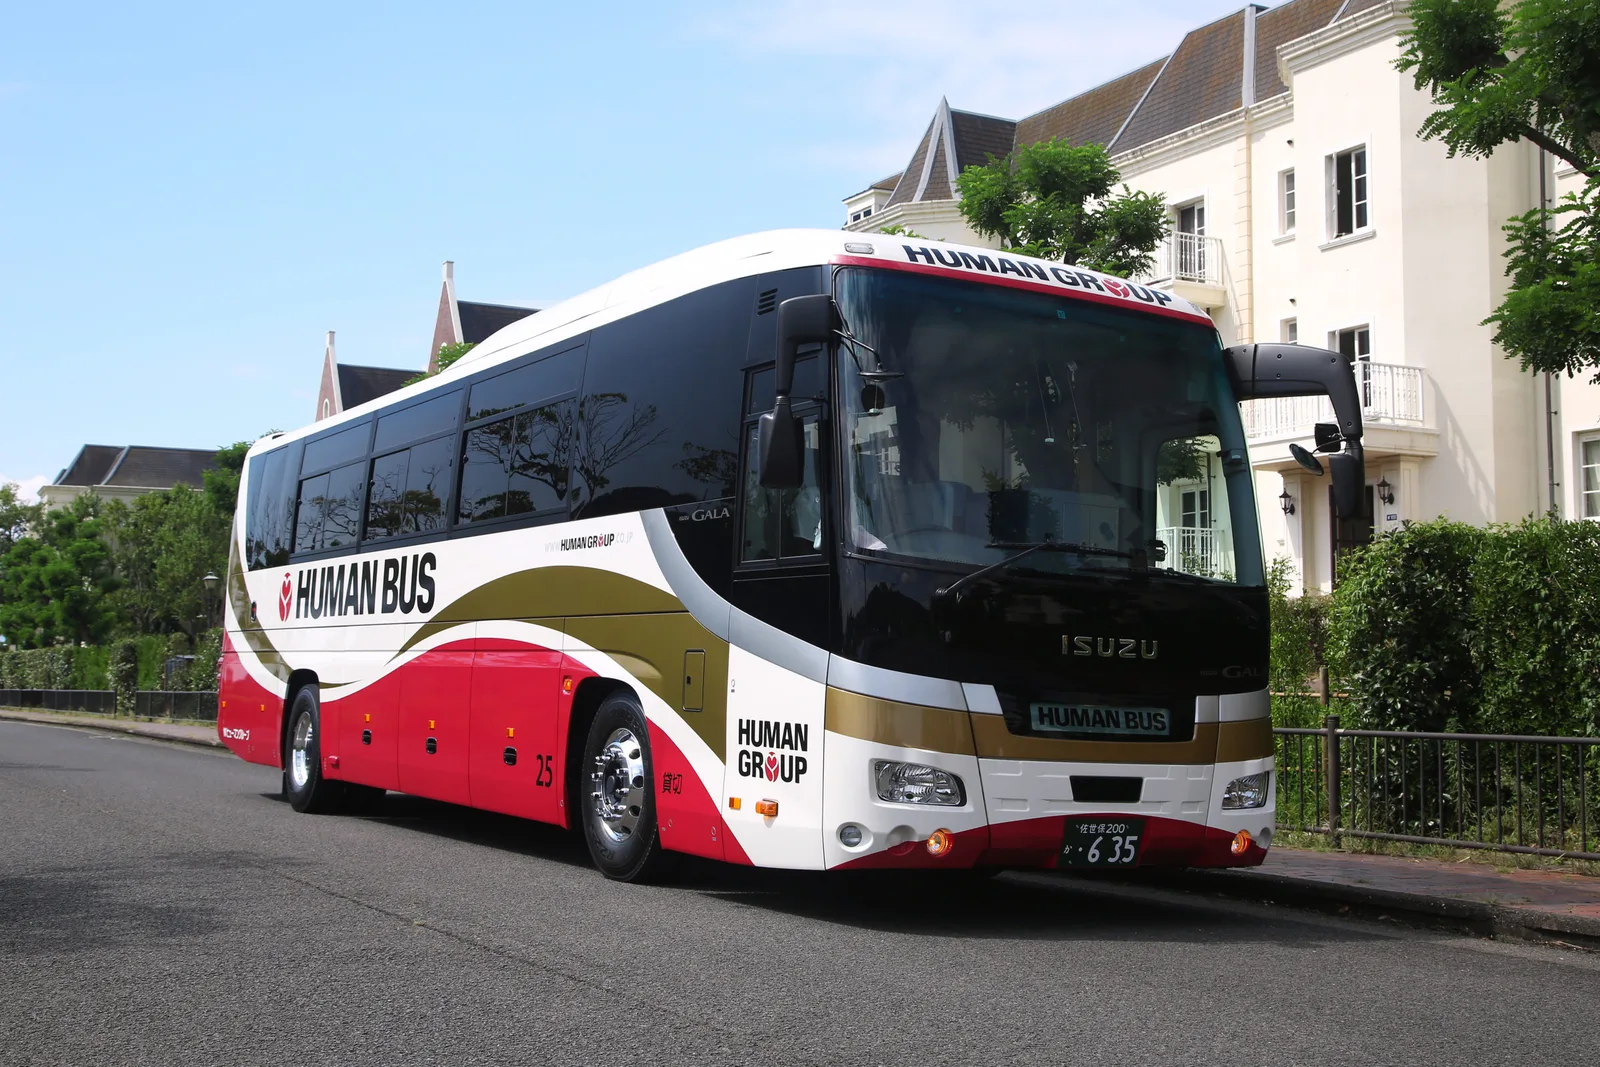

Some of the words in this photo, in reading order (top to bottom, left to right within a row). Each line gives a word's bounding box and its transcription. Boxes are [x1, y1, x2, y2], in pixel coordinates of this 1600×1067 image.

[902, 245, 1050, 282] HUMAN
[692, 507, 730, 522] GALA
[296, 560, 378, 619] HUMAN
[381, 552, 436, 614] BUS
[1061, 634, 1158, 659] ISUZU
[1222, 665, 1265, 678] GAL
[1038, 706, 1120, 729] HUMAN
[1124, 711, 1166, 731] BUS
[738, 718, 808, 752] HUMAN
[536, 754, 553, 788] 25
[662, 772, 683, 795] 貸切
